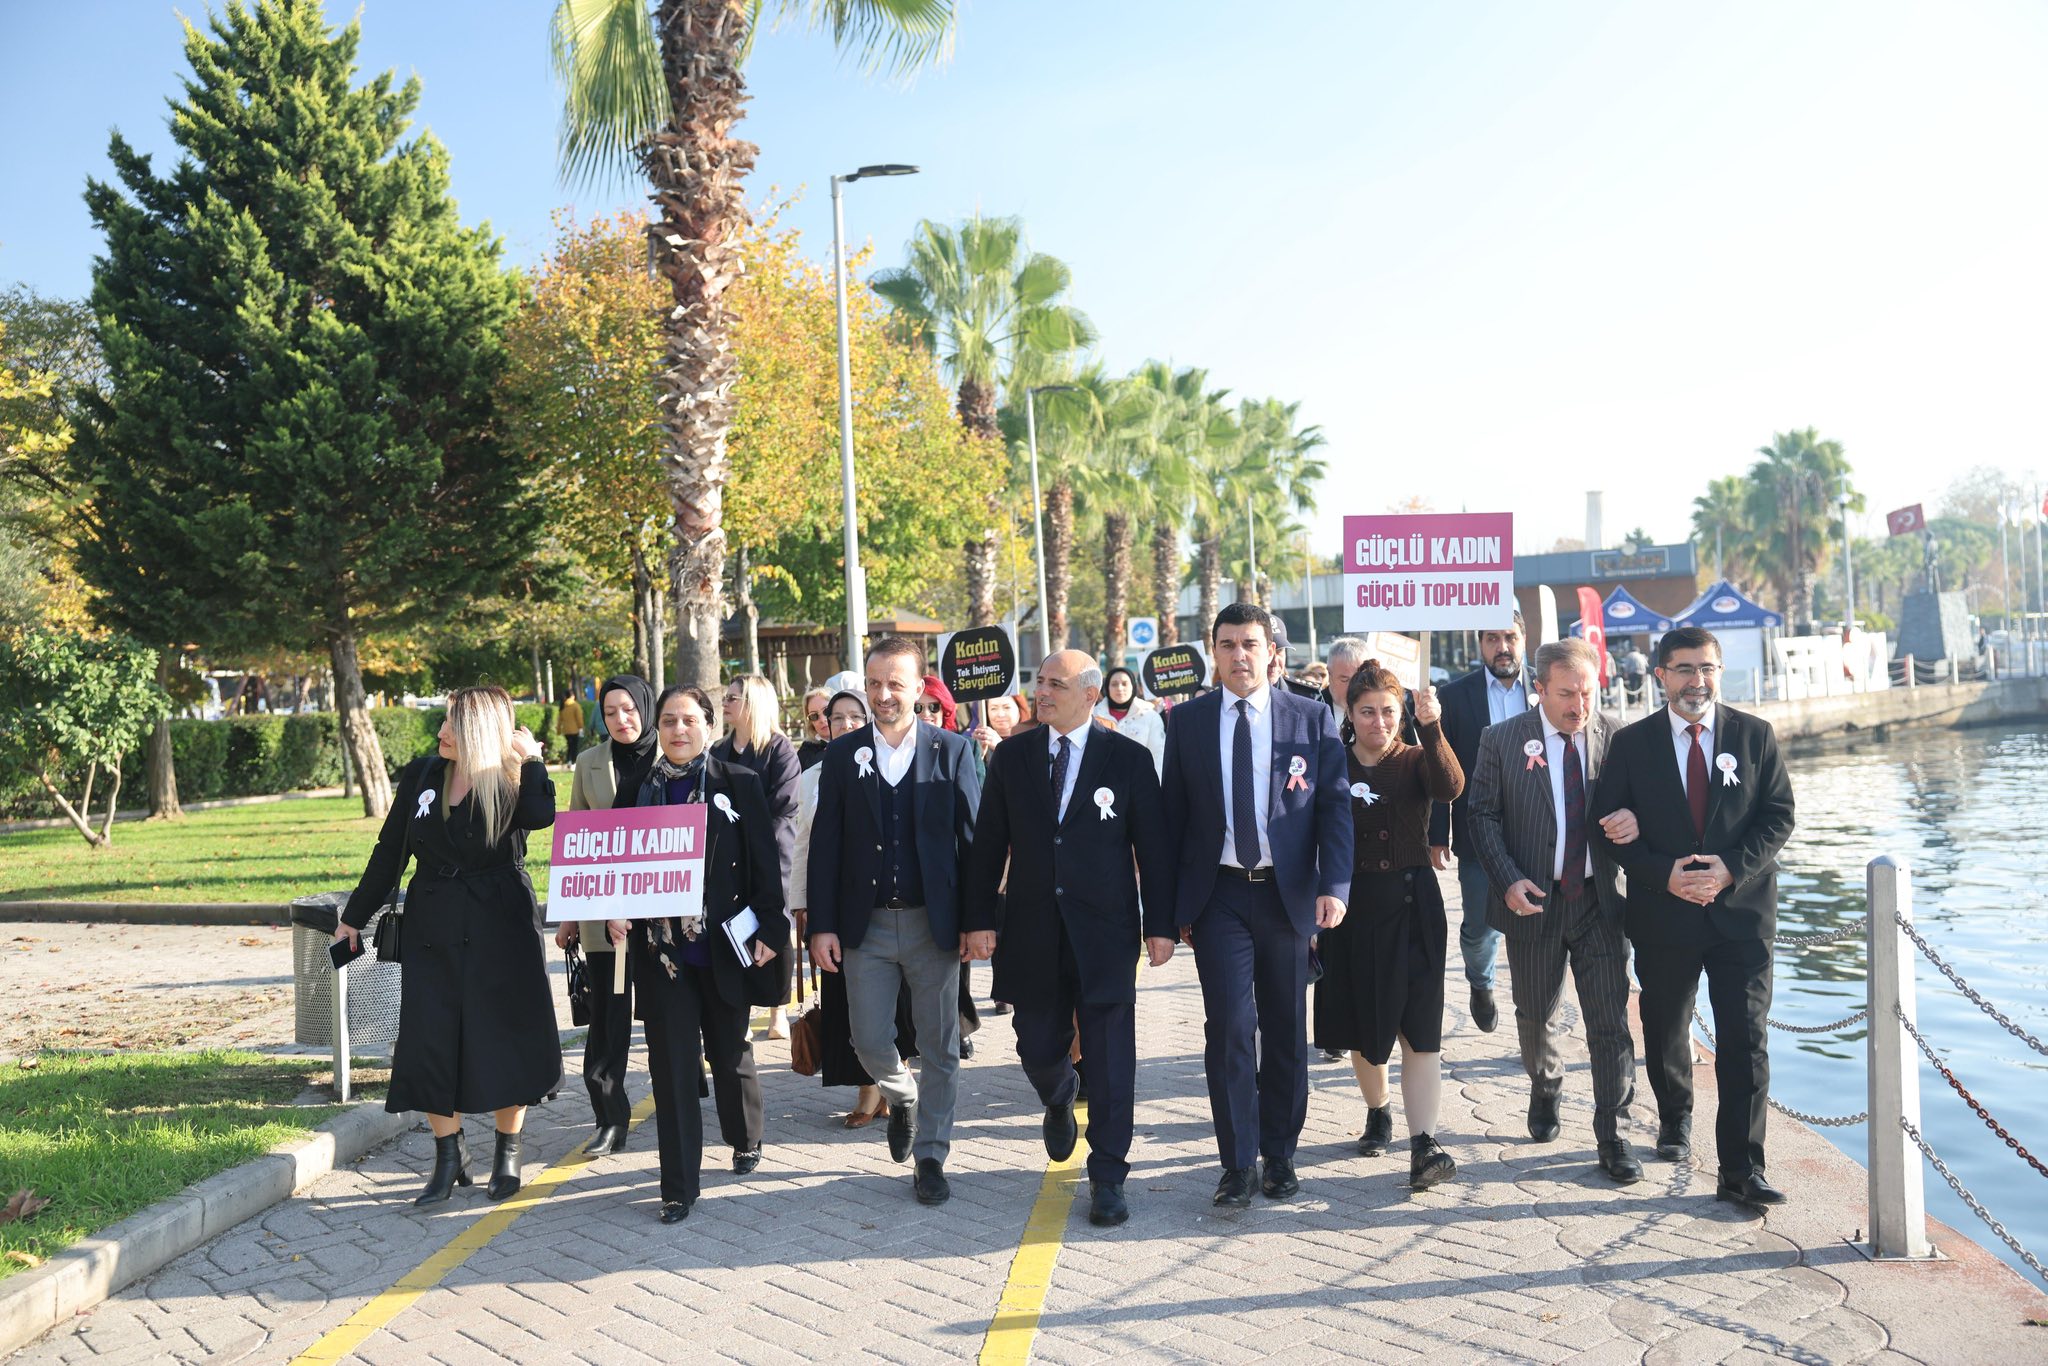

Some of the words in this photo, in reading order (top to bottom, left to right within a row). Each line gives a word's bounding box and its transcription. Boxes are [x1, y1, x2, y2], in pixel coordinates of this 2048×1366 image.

[1355, 533, 1424, 570] GÜÇLÜ
[1431, 536, 1501, 565] KADIN
[1356, 579, 1416, 611] GÜÇLÜ
[1421, 582, 1500, 606] TOPLUM
[955, 638, 999, 659] Kadın
[1152, 653, 1191, 669] Kadın
[956, 668, 971, 677] Tek
[972, 664, 1001, 676] İhtiyacı
[958, 673, 1002, 690] Sevgidir
[563, 826, 626, 862] GÜÇLÜ
[631, 826, 695, 856] KADIN
[560, 870, 616, 900] GÜÇLÜ
[621, 869, 692, 896] TOPLUM
